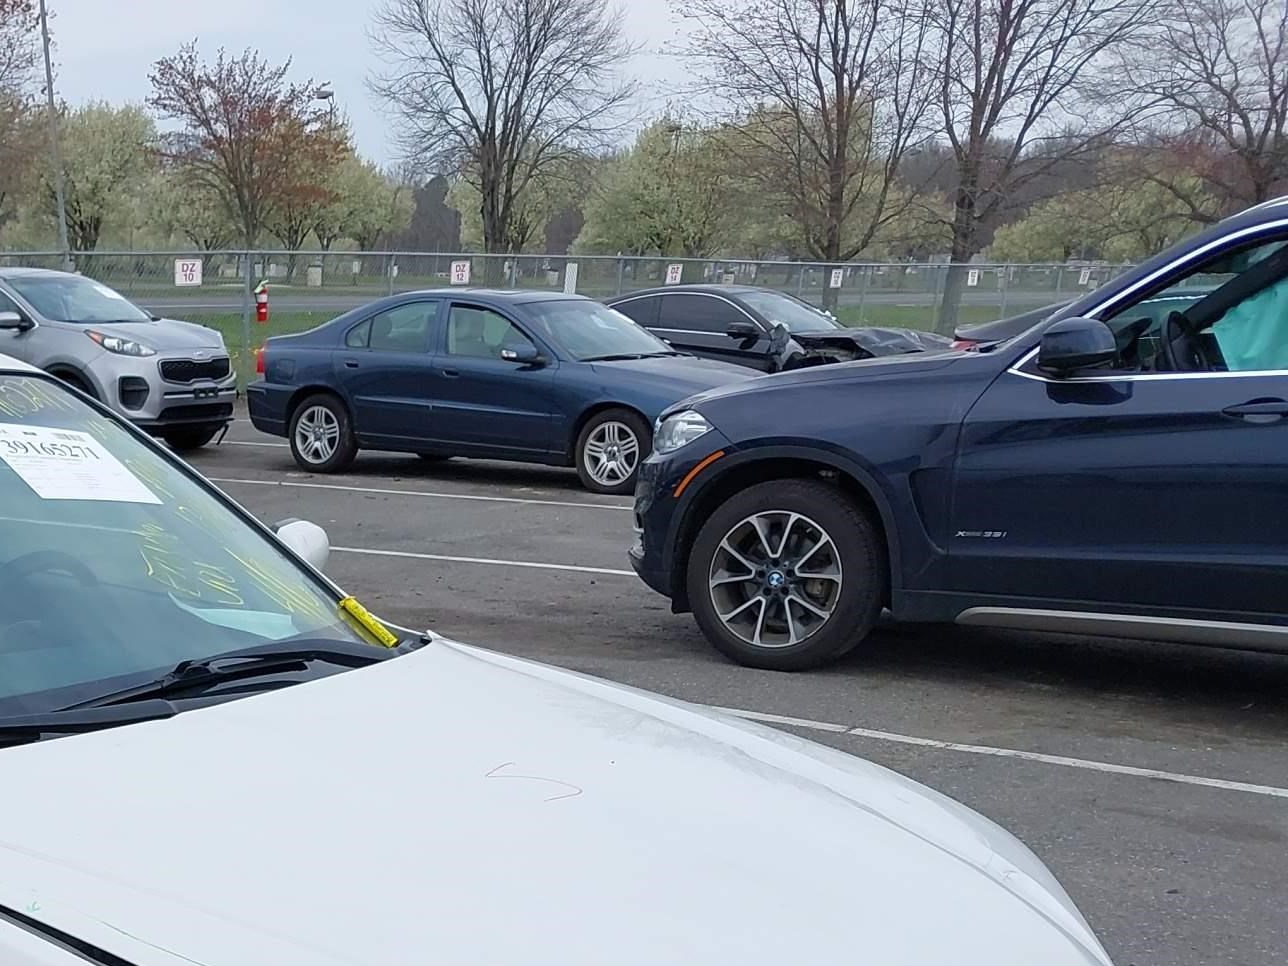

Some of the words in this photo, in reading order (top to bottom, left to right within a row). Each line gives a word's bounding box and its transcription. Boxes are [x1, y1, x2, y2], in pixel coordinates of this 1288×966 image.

[182, 263, 196, 273] DZ
[455, 264, 466, 273] DZ
[183, 273, 194, 282] 10
[0, 438, 100, 460] 39165271
